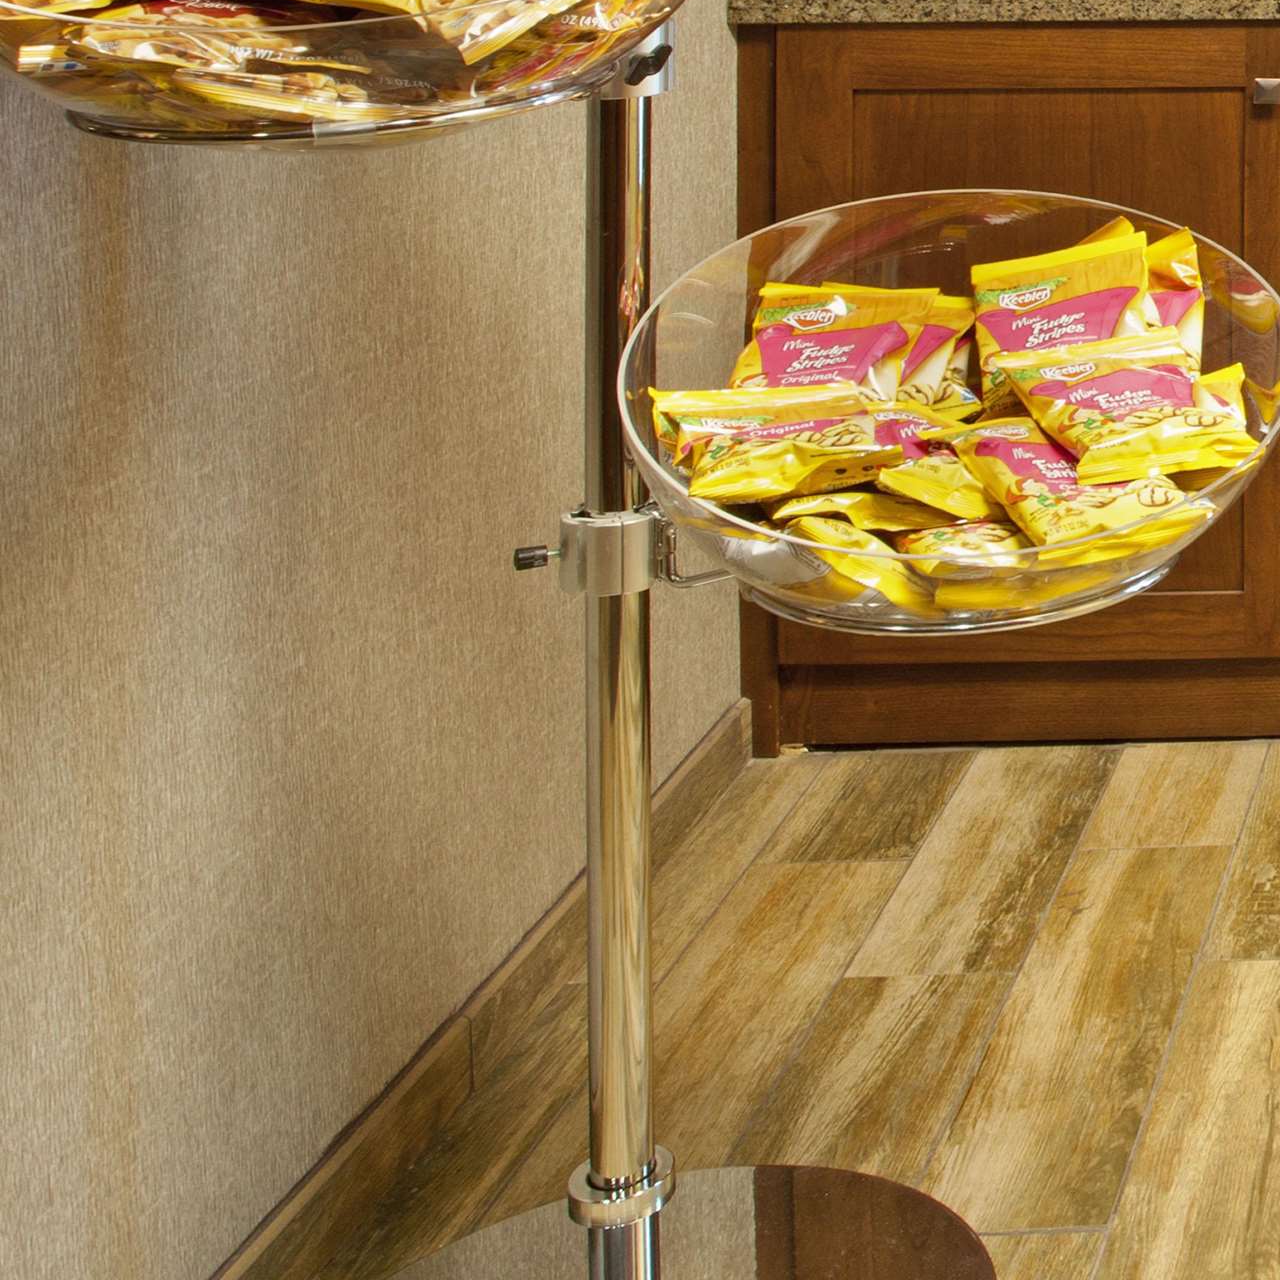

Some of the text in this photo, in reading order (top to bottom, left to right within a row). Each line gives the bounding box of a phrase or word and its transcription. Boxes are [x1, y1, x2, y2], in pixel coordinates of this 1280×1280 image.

[561, 15, 577, 25] OZ
[1001, 290, 1050, 307] Keebler
[1011, 316, 1041, 330] Mini
[1033, 312, 1085, 334] Fudge
[1025, 322, 1086, 348] Stripes
[783, 340, 814, 352] Mini
[801, 344, 855, 359] Fudge
[786, 356, 848, 373] Stripes
[1043, 363, 1095, 378] Keebler
[781, 372, 840, 385] Original
[1069, 387, 1098, 403] Mini
[751, 421, 815, 437] Original
